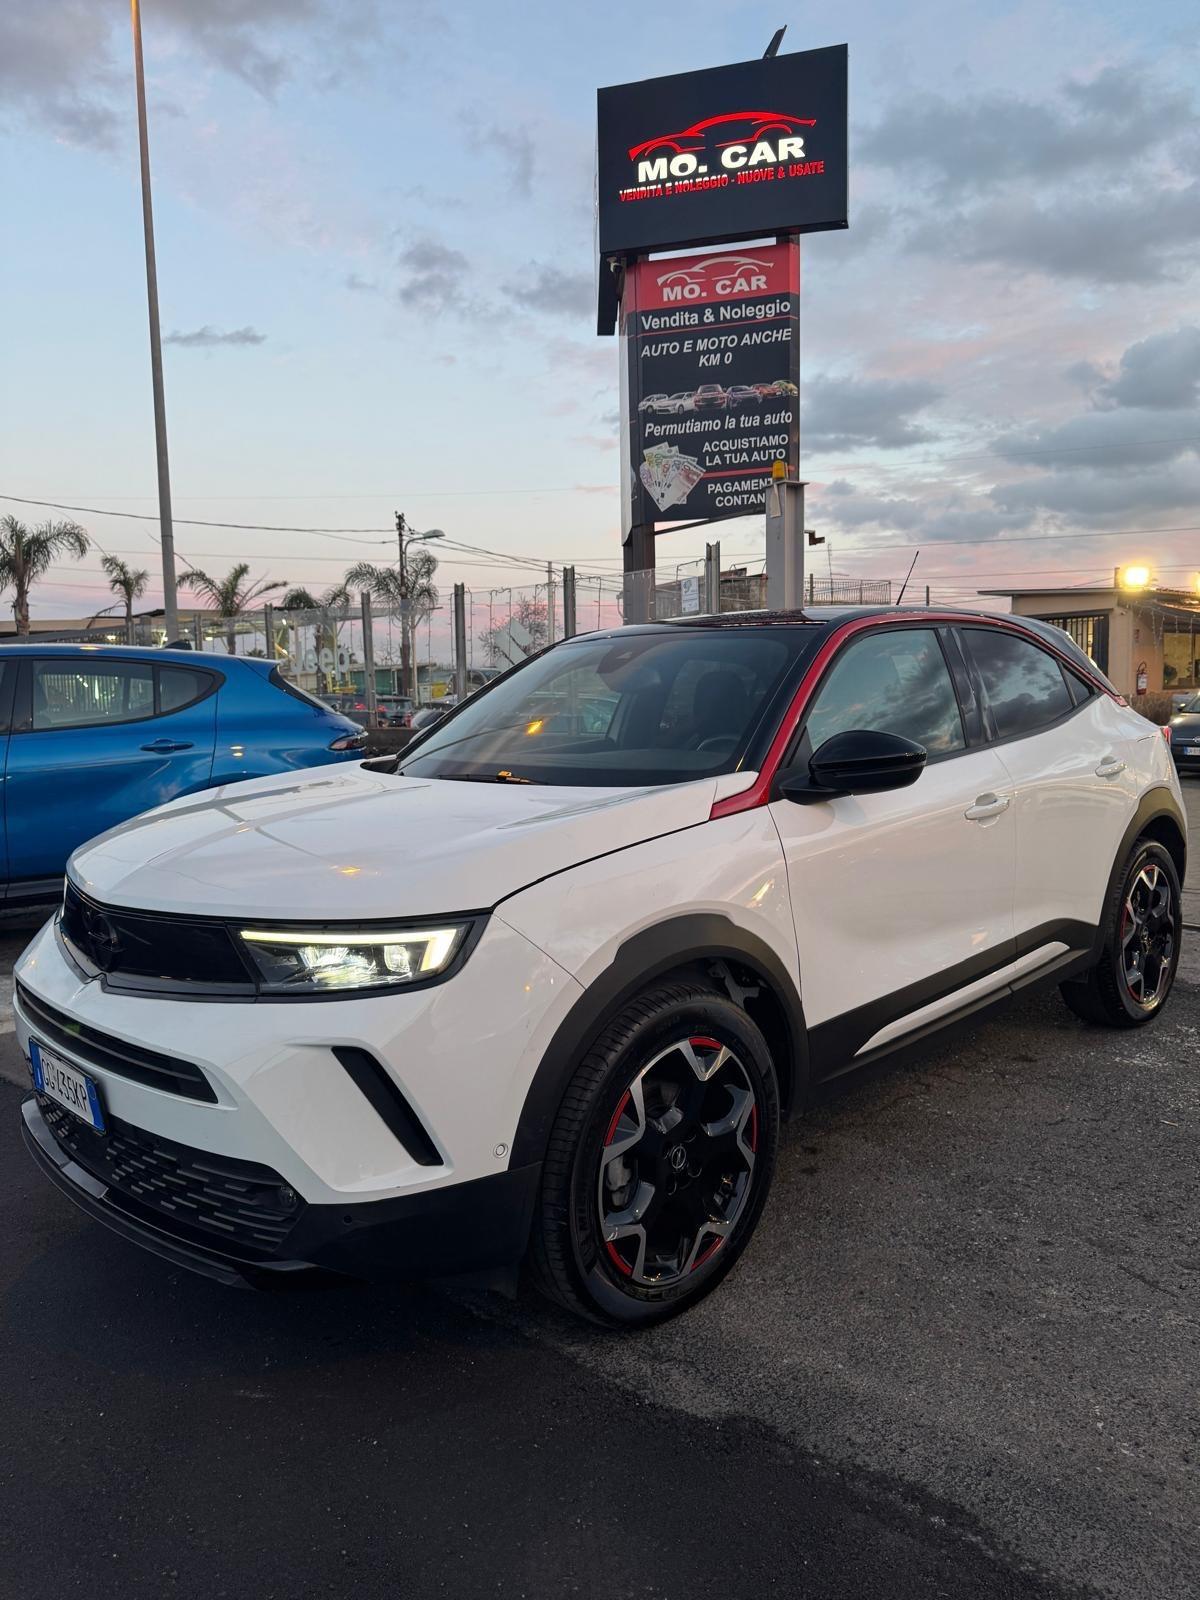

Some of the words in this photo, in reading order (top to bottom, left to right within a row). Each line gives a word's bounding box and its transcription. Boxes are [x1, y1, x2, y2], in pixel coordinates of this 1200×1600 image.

[638, 154, 707, 183] MO.
[720, 136, 806, 169] CAR
[619, 184, 663, 202] VENDITA
[665, 182, 673, 195] E
[674, 173, 729, 194] NOLEGGIO
[737, 167, 775, 185] NUOVE
[777, 167, 786, 180] &
[788, 160, 825, 178] USATE
[662, 284, 708, 302] MO.
[715, 275, 768, 295] CAR
[641, 310, 699, 331] Vendita
[703, 307, 715, 323] &
[719, 299, 791, 321] Noleggio
[640, 341, 680, 359] AUTO
[683, 340, 694, 353] E
[696, 334, 738, 352] MOTO
[740, 328, 792, 347] ANCHE
[698, 352, 721, 367] KM
[724, 351, 733, 365] 0
[645, 417, 721, 438] Permutiamo
[724, 415, 736, 431] la
[739, 414, 760, 429] tua
[763, 409, 793, 426] auto
[702, 433, 789, 453] ACQUISTIAMO
[705, 456, 721, 467] LA
[724, 452, 749, 465] TUA
[751, 448, 786, 463] AUTO
[290, 640, 350, 681] Jeep
